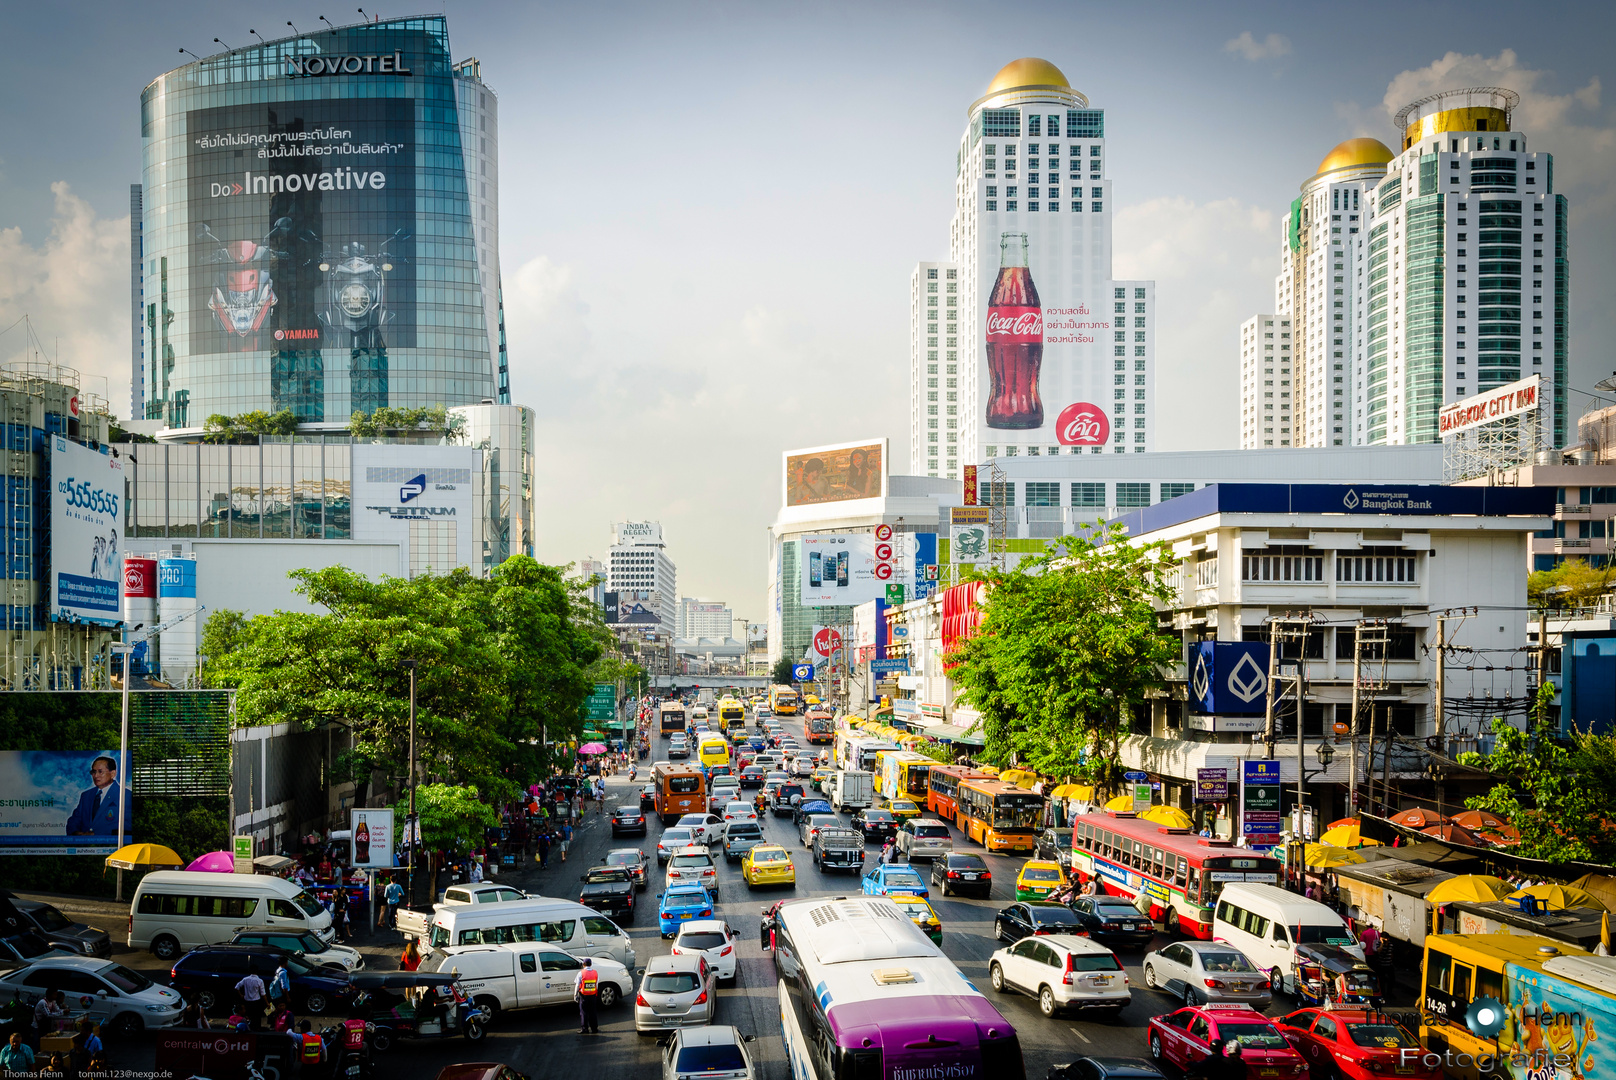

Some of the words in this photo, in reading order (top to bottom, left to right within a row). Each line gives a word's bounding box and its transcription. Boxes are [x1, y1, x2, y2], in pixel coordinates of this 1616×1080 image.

[284, 49, 411, 77] NOVOTEL
[211, 182, 231, 198] Do
[245, 166, 386, 195] Innovative
[1046, 303, 1090, 315] ความสดชื่น
[986, 312, 1043, 336] Coca-Cola
[1046, 319, 1110, 329] อย่างเป็นทางการ
[284, 328, 319, 340] YAMAHA
[1046, 333, 1094, 343] ของหน้าร้อน
[1440, 401, 1488, 433] BANGKOK
[1489, 392, 1515, 417] CITY
[1516, 385, 1536, 409] INN
[1362, 499, 1405, 511] Bangkok
[1406, 500, 1432, 509] Bank
[1426, 997, 1447, 1014] 14-26
[350, 1032, 362, 1044] 18
